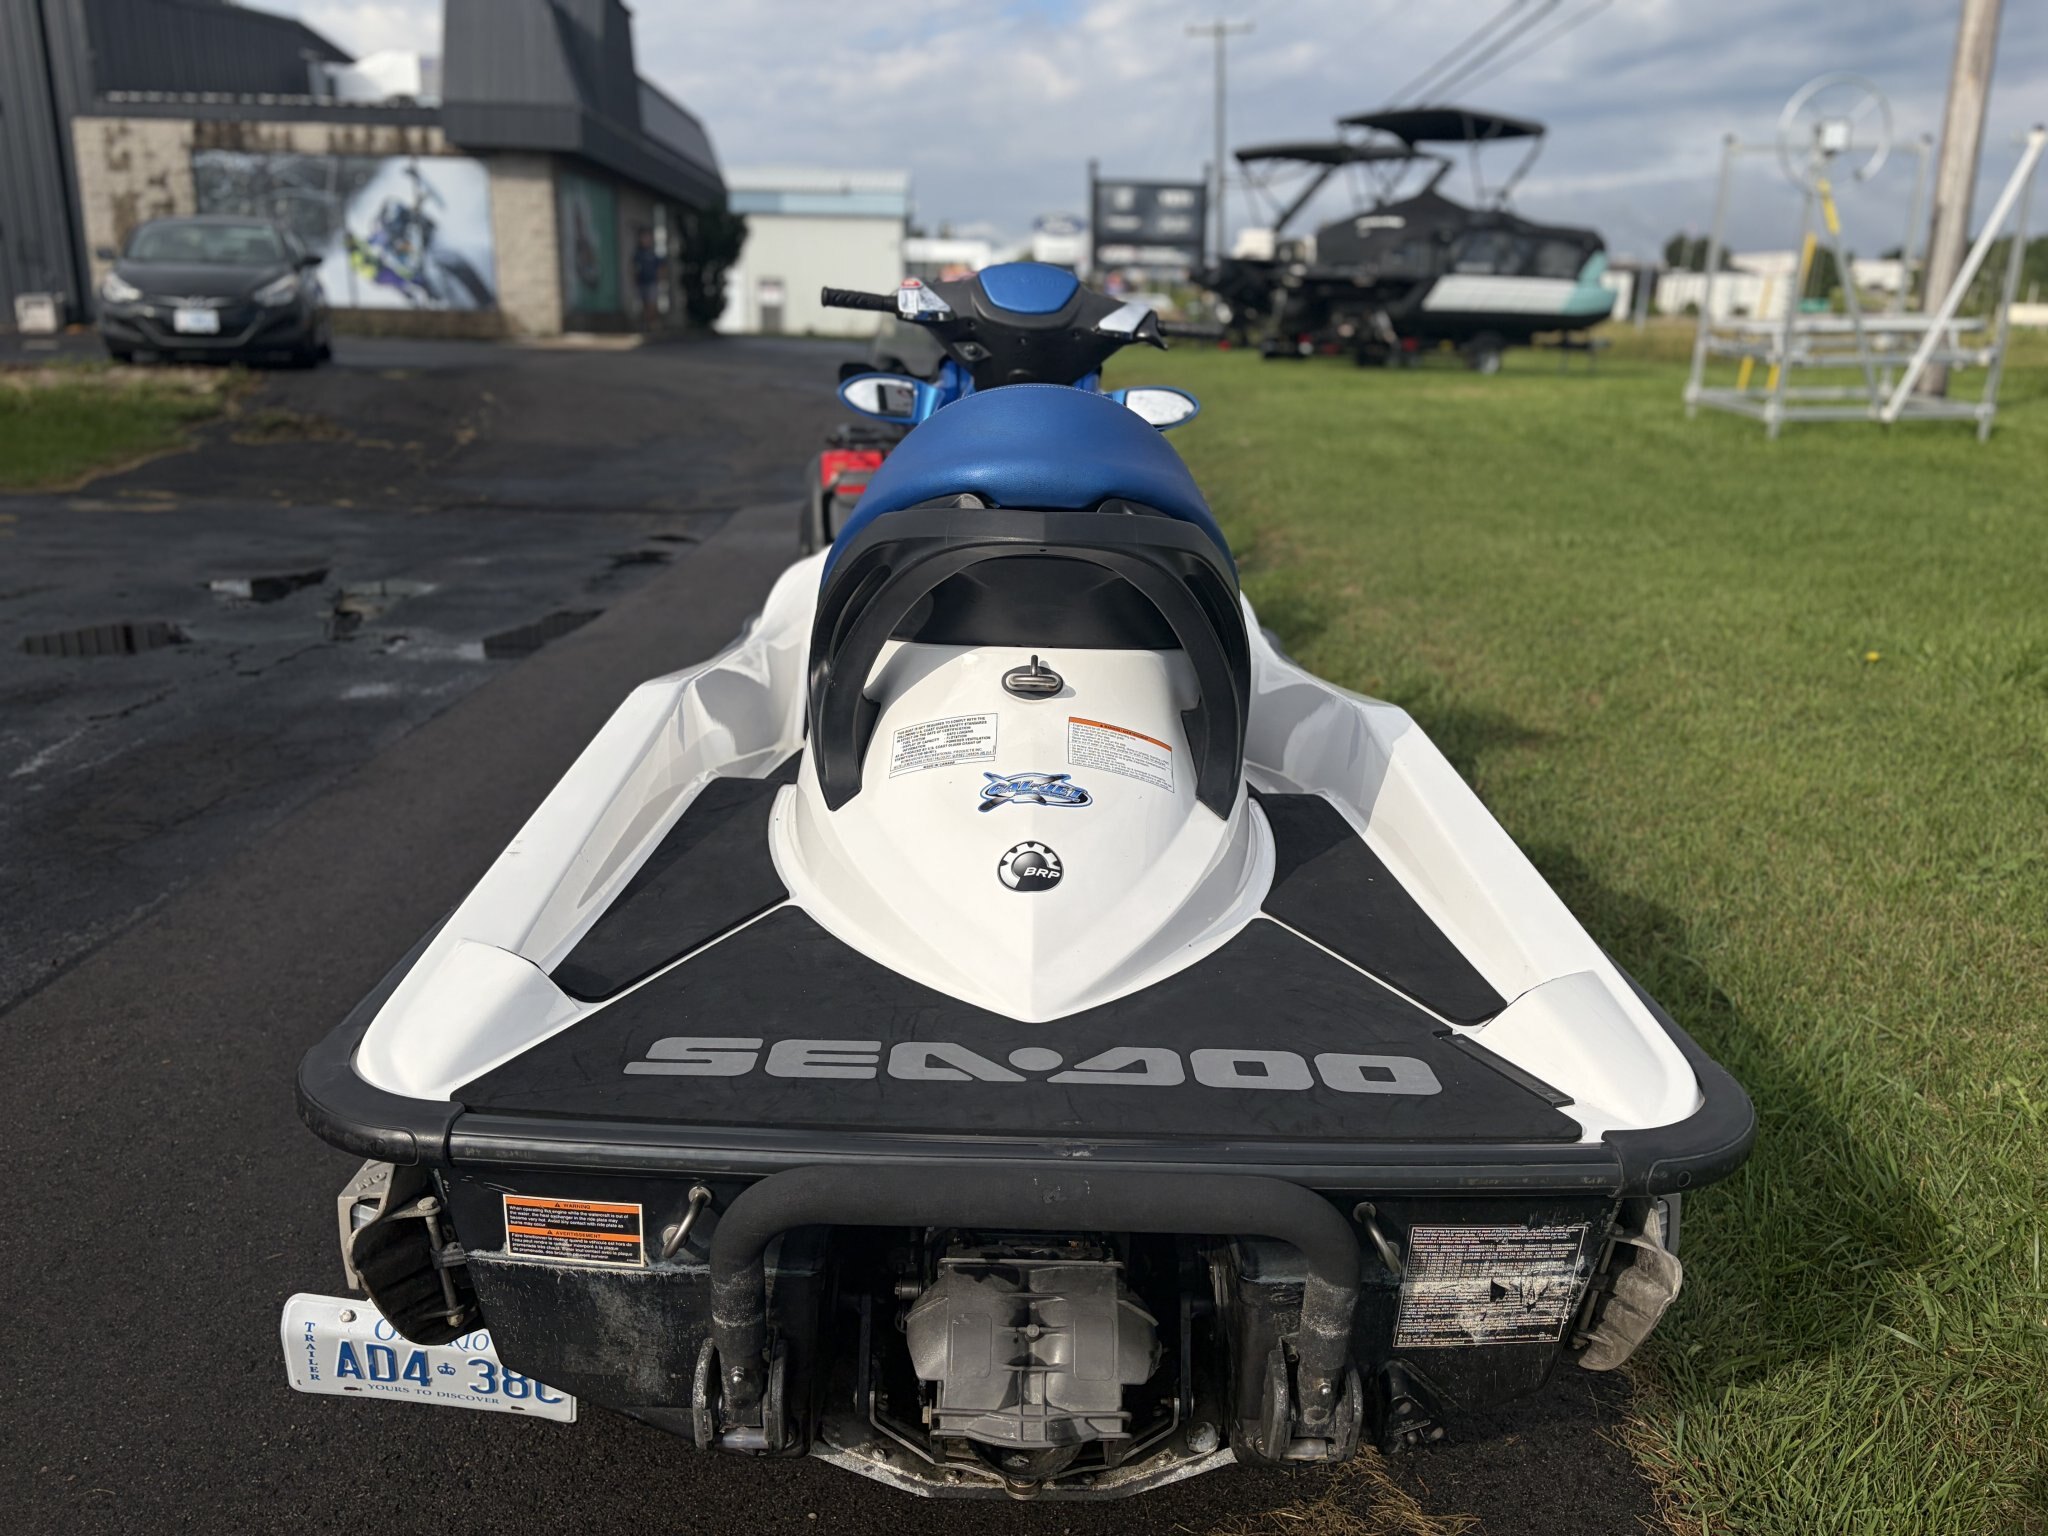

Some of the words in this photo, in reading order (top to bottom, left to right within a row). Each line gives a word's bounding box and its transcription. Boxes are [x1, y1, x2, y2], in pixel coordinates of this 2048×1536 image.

[1024, 867, 1060, 878] BRP
[304, 1322, 320, 1380] TRAILER
[368, 1384, 410, 1393] YOURS
[437, 1391, 499, 1404] DISCOVER
